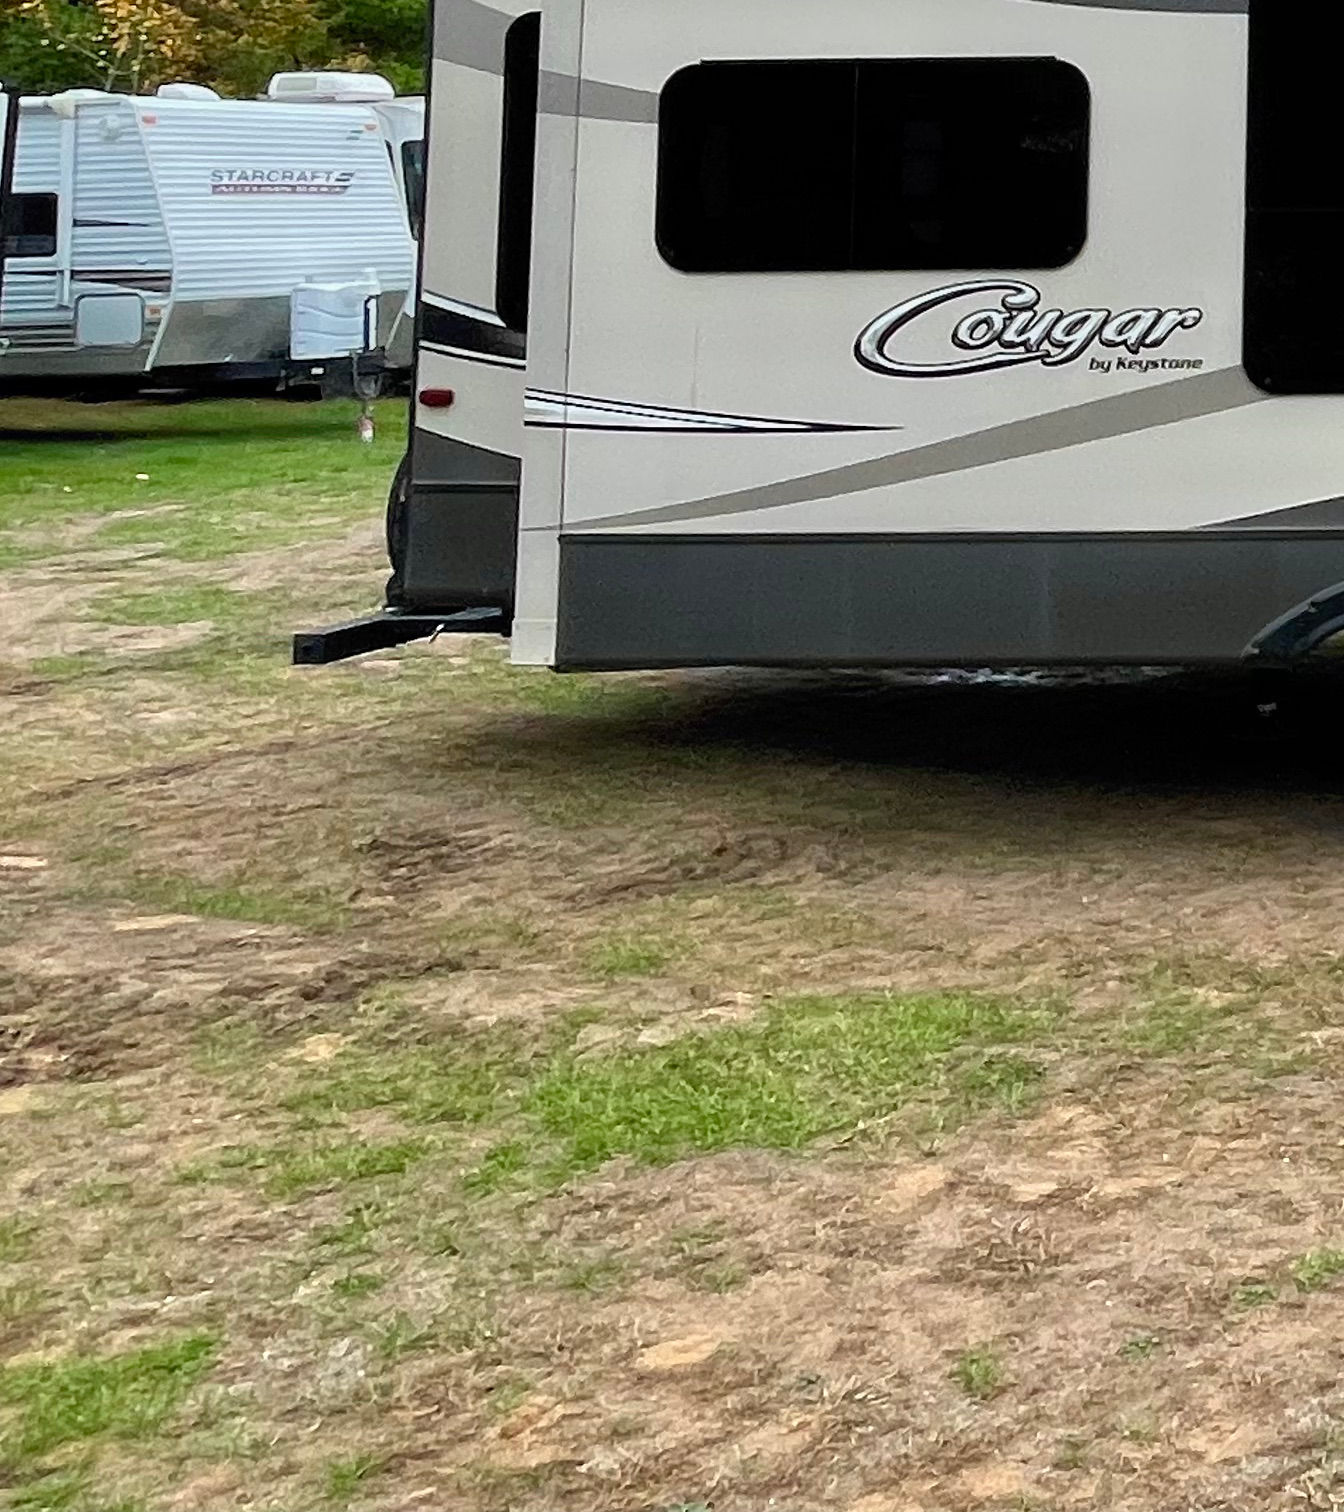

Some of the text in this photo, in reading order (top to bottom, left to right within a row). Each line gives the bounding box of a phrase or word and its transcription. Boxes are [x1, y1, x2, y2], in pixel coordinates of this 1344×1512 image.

[210, 169, 334, 183] STARCRAFT
[853, 279, 1203, 378] Cougar
[1088, 357, 1203, 374] by Keystone
